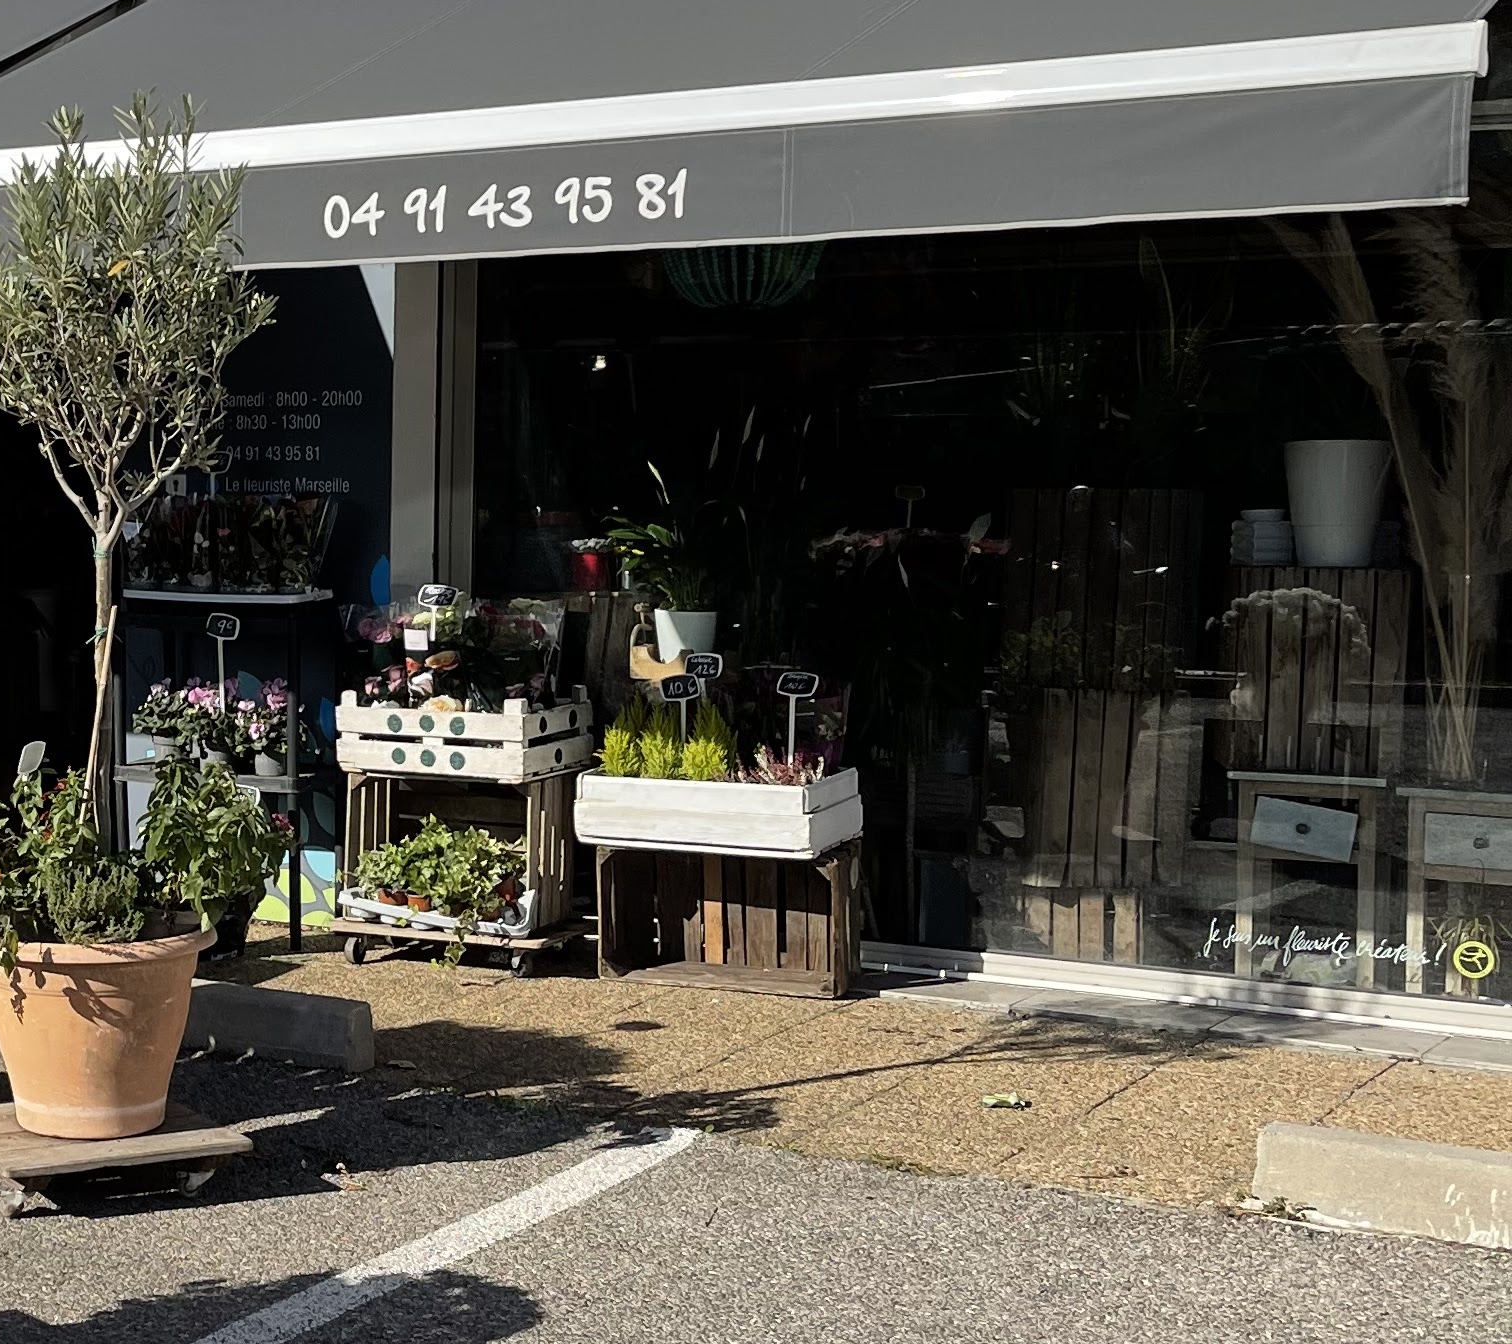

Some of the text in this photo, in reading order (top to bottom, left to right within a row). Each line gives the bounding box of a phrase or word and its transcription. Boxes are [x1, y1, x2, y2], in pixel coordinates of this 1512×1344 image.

[323, 168, 688, 239] 04 91 43 95 81
[275, 391, 308, 407] 8h00
[321, 390, 363, 407] 20h00
[235, 414, 268, 430] 8h30
[281, 413, 321, 430] 13h00
[245, 445, 260, 461] 91
[264, 445, 282, 462] 43
[284, 445, 301, 462] 95
[304, 445, 321, 462] 81
[225, 476, 350, 494] Le fleuriste Marseille
[1203, 917, 1220, 957] Je
[1282, 925, 1350, 967] fleuriste
[1356, 939, 1431, 964] créateur
